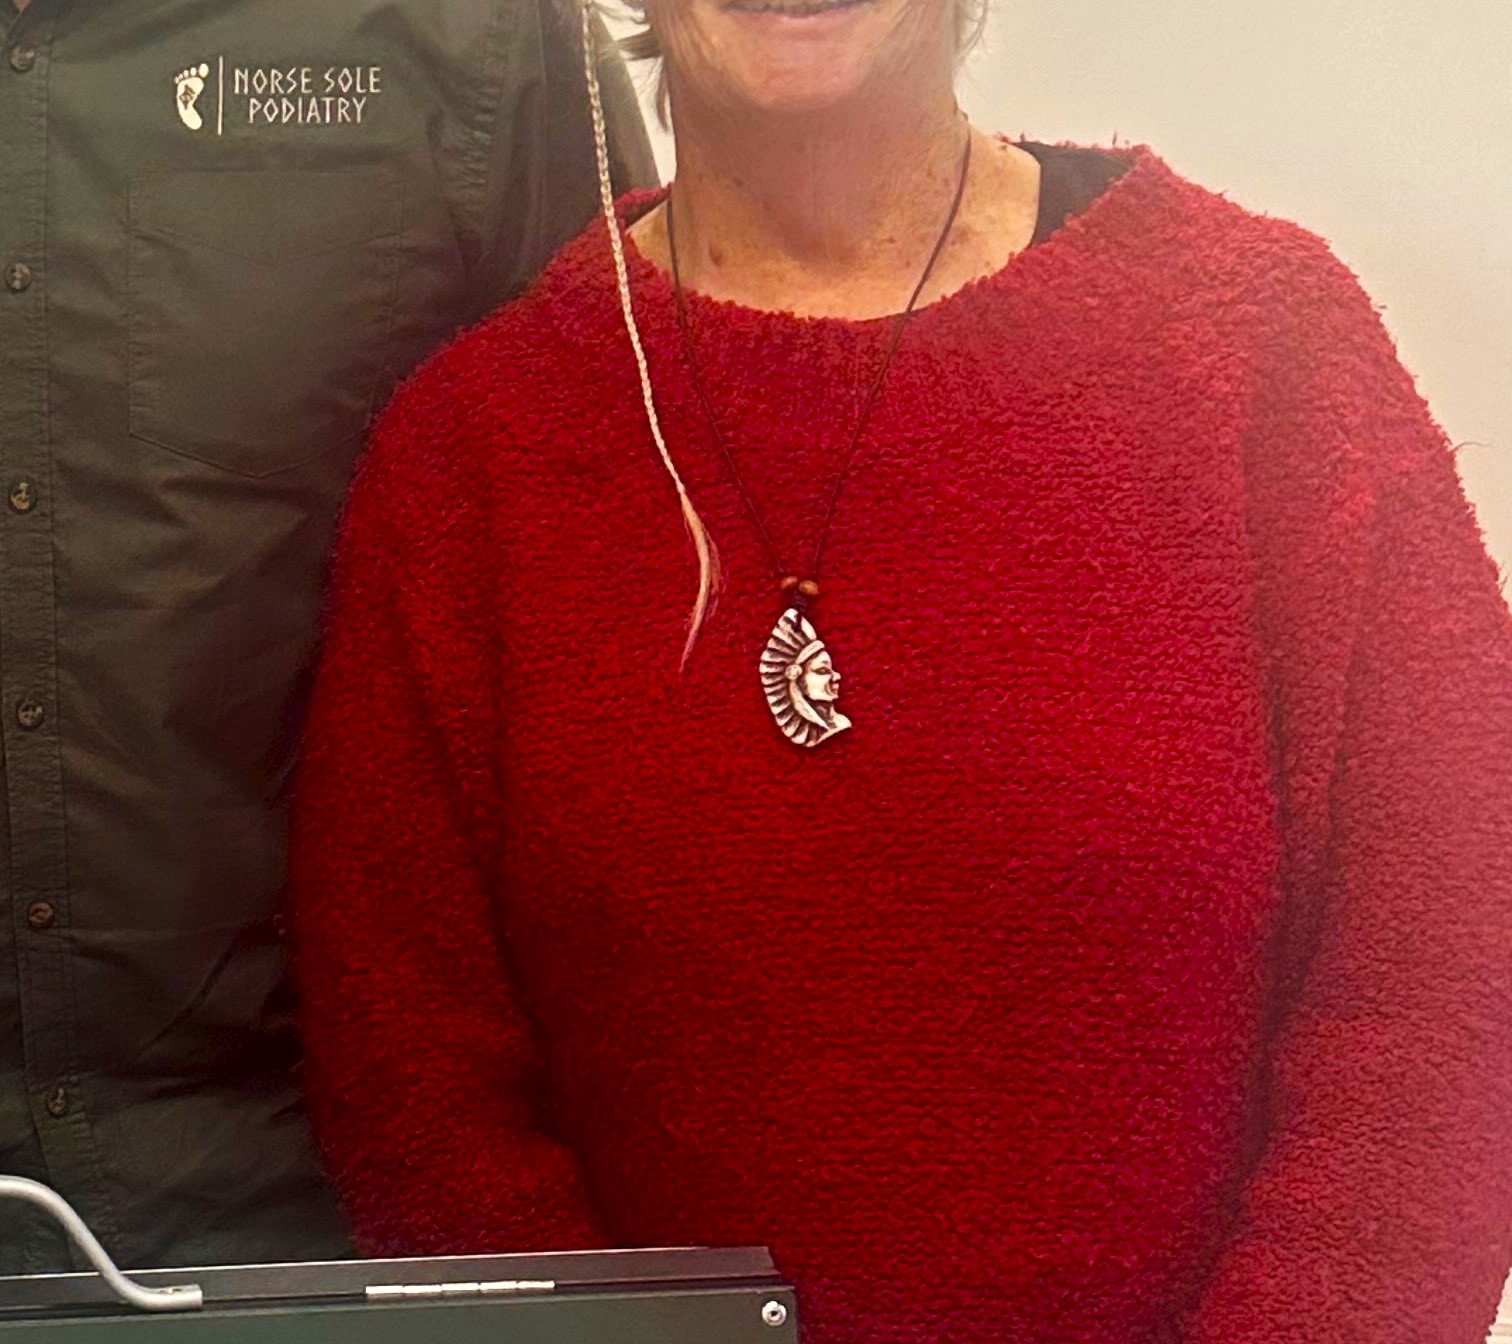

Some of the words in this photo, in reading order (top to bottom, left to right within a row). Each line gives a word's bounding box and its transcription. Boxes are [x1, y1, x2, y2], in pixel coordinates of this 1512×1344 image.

[234, 68, 313, 94] NORSE
[324, 66, 381, 94] SOLE
[248, 96, 367, 124] PODIATRY
